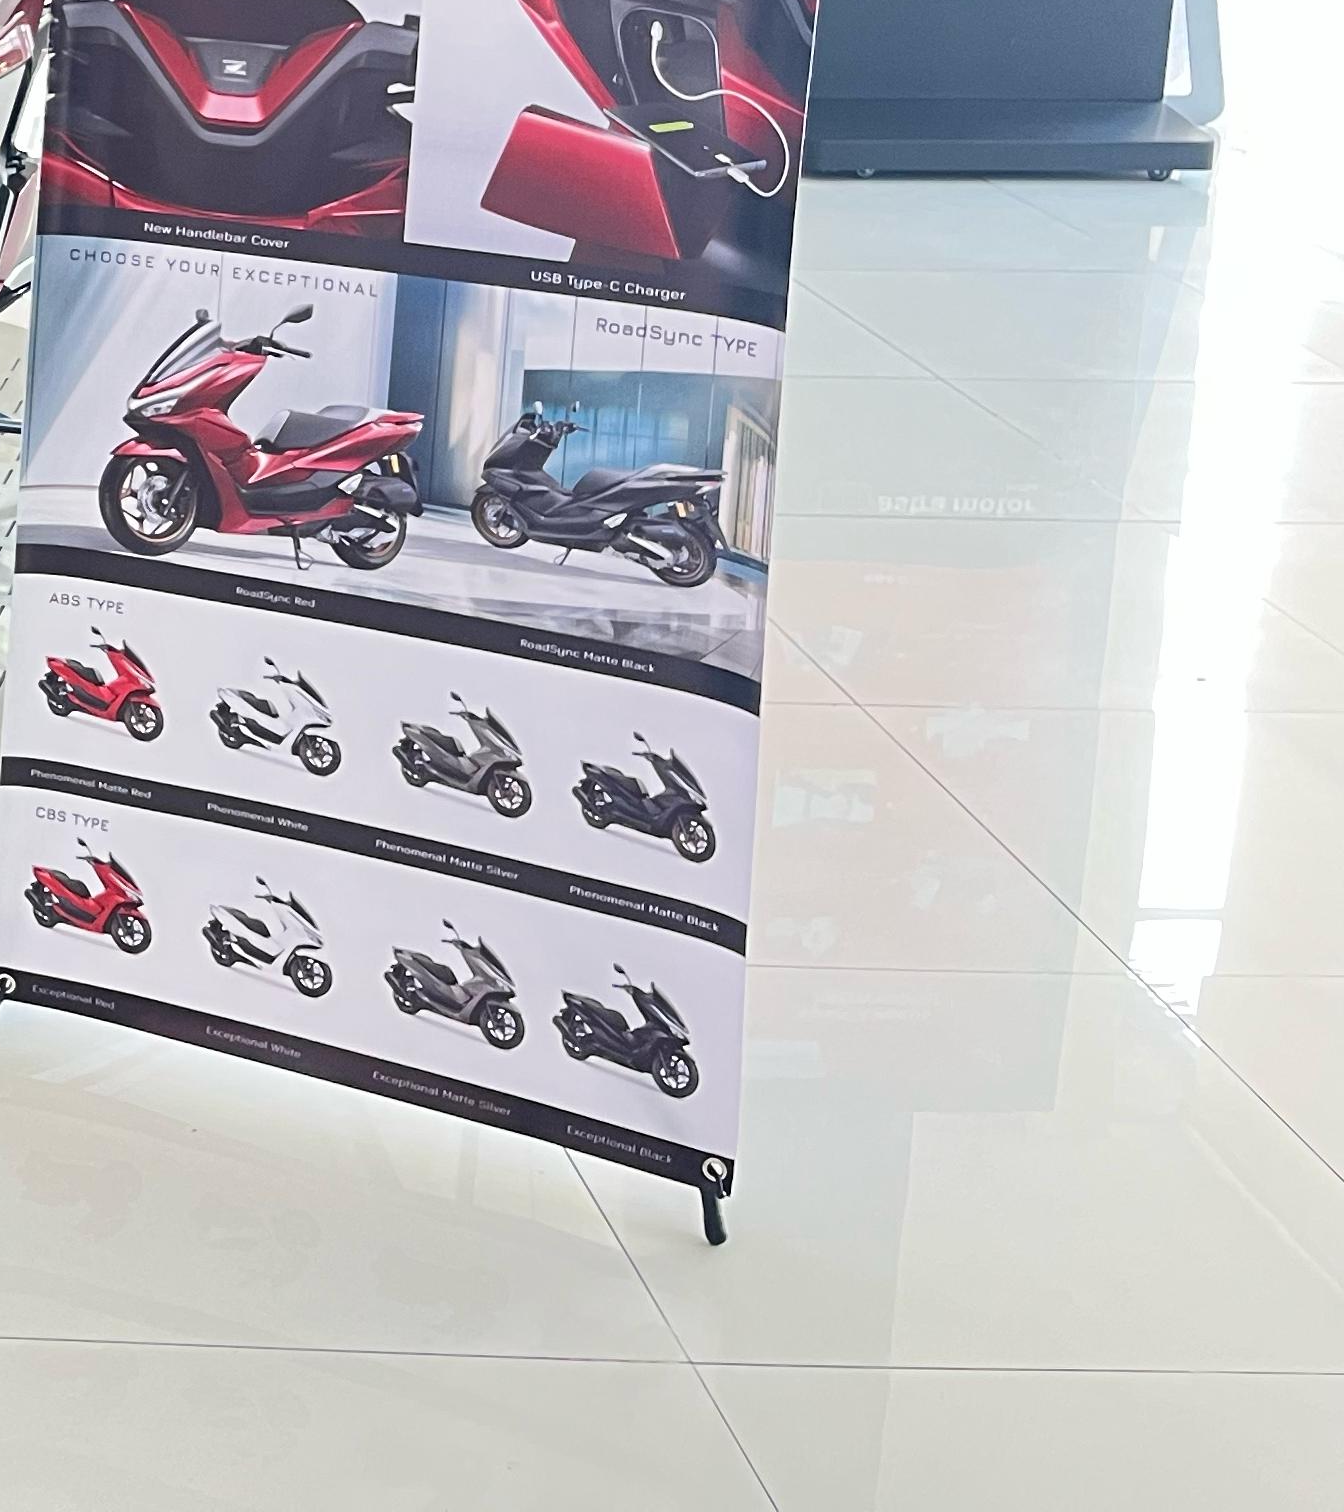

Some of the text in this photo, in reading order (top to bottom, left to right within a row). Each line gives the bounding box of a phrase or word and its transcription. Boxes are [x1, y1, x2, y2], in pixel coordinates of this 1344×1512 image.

[143, 221, 291, 250] New Handlebar Cover
[69, 248, 379, 298] CHOOSE YOUR EXCEPTIONAL
[530, 270, 562, 285] USB
[624, 282, 687, 302] Charger
[595, 317, 758, 358] RoadSync TYPE
[48, 592, 124, 614] ABS TYPE
[235, 586, 316, 608] RoadSync Red
[519, 638, 656, 673] RoadSync Matte Black
[30, 768, 152, 799] Phenomenal Matte Red
[35, 806, 110, 832] CBS TYPE
[206, 802, 310, 832] Phenomenal White
[374, 838, 521, 881] Phenomenal Matte Silver
[568, 884, 721, 932] Phenomenal Matte Black
[31, 984, 116, 1010] Exceptional Red
[205, 1025, 302, 1059] Exceptional White
[372, 1070, 512, 1117] Exceptional Matte Silver
[565, 1124, 673, 1164] Exceptional Black
